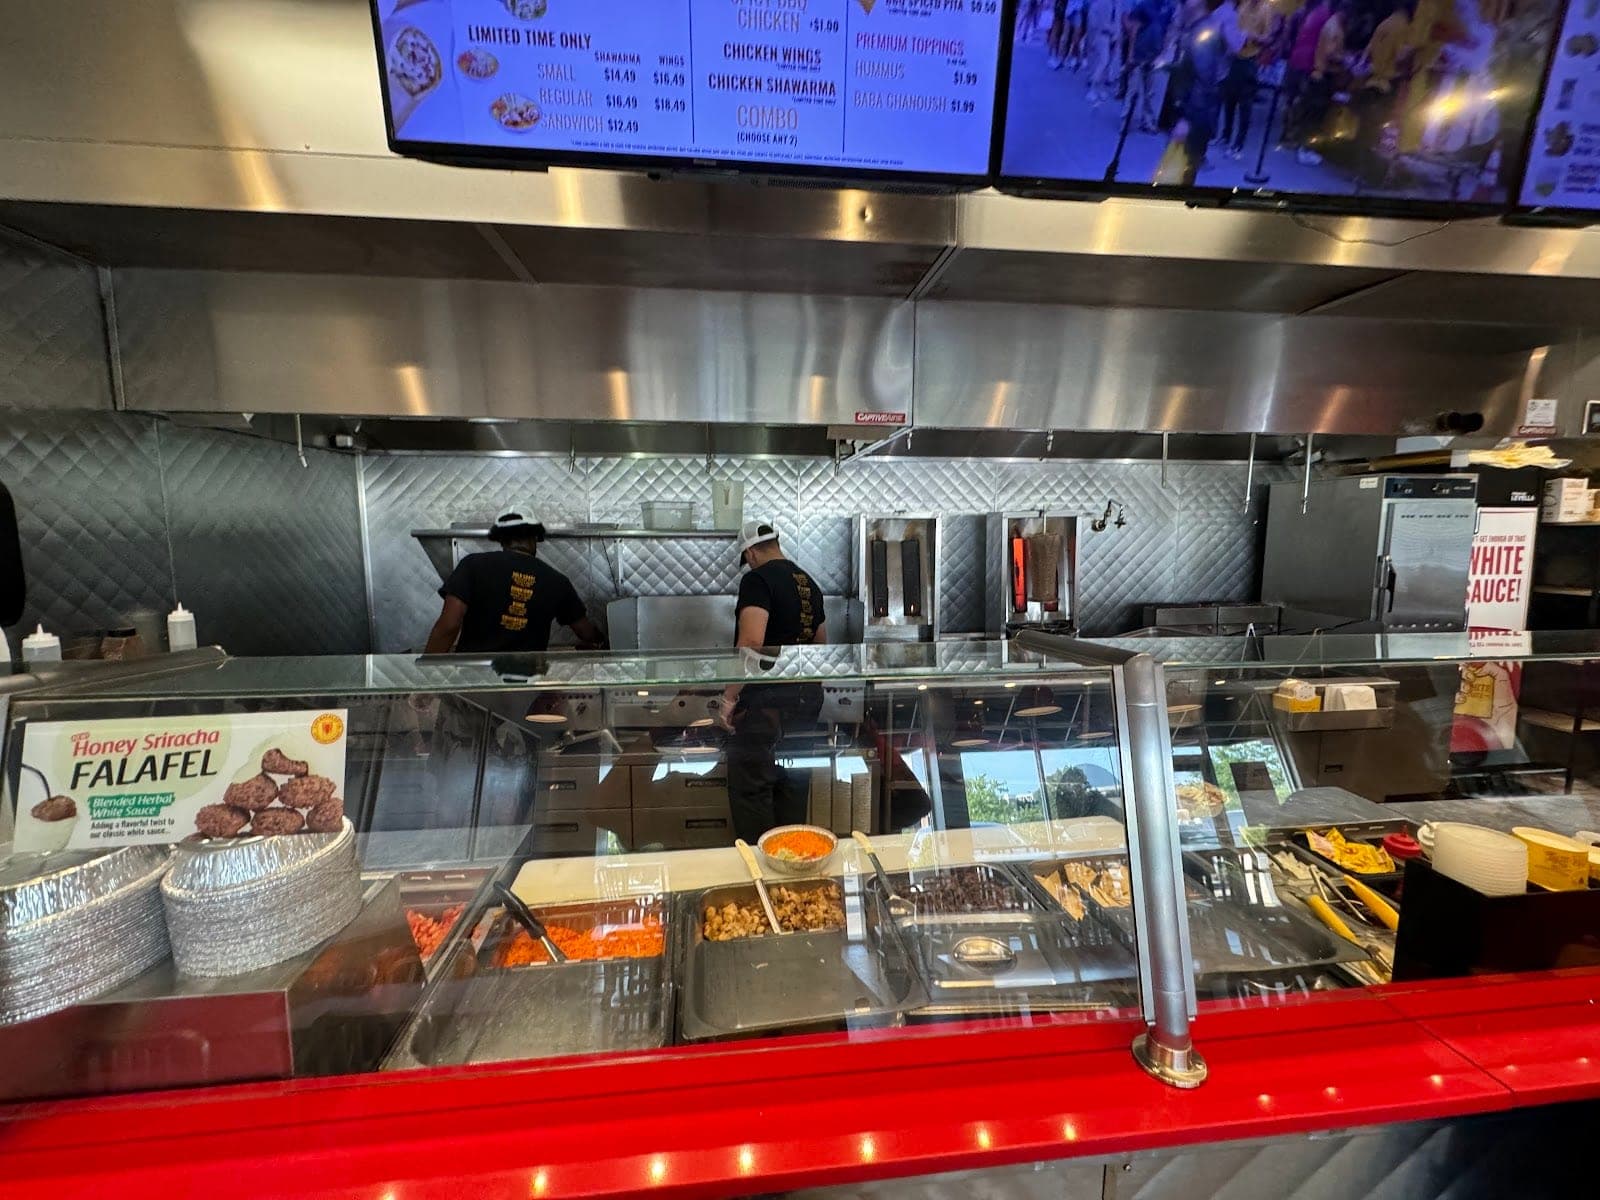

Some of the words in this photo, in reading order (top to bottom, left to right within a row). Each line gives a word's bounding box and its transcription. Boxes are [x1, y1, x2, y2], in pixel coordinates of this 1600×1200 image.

[738, 8, 800, 32] CHICKEN
[468, 24, 520, 45] LIMITED
[526, 28, 556, 48] TIME
[560, 32, 591, 50] ONLY
[856, 32, 908, 52] PREMIUM
[912, 37, 964, 57] TOPPINGS
[594, 52, 641, 66] SHAWARMA
[658, 56, 685, 66] WINGS
[723, 42, 778, 62] CHICKEN
[782, 46, 822, 65] WINGS
[537, 63, 576, 82] SMALL
[604, 68, 636, 82] $14.49
[708, 72, 762, 92] CHICKEN
[766, 76, 836, 96] SHAWARMA
[855, 59, 904, 80] HUMMUS
[954, 70, 978, 86] $1.99
[539, 87, 593, 108] REGULAR
[854, 90, 882, 109] BABA
[950, 99, 974, 114] $1.99
[541, 113, 603, 134] SANDWICH
[608, 118, 639, 134] $12.49
[737, 104, 798, 130] COMBO
[737, 132, 770, 144] (CHOOSE
[772, 134, 787, 145] ANY
[73, 737, 138, 757] Honey
[142, 729, 220, 751] Sriracha
[70, 749, 218, 790] FALAFEL
[92, 796, 136, 808] Blended
[138, 794, 172, 805] Herbal
[92, 806, 124, 818] White
[125, 806, 156, 816] Sauce
[92, 821, 114, 830] Adding
[122, 819, 148, 828] flavorful
[150, 818, 166, 826] twist
[168, 818, 175, 826] to
[127, 828, 145, 836] white
